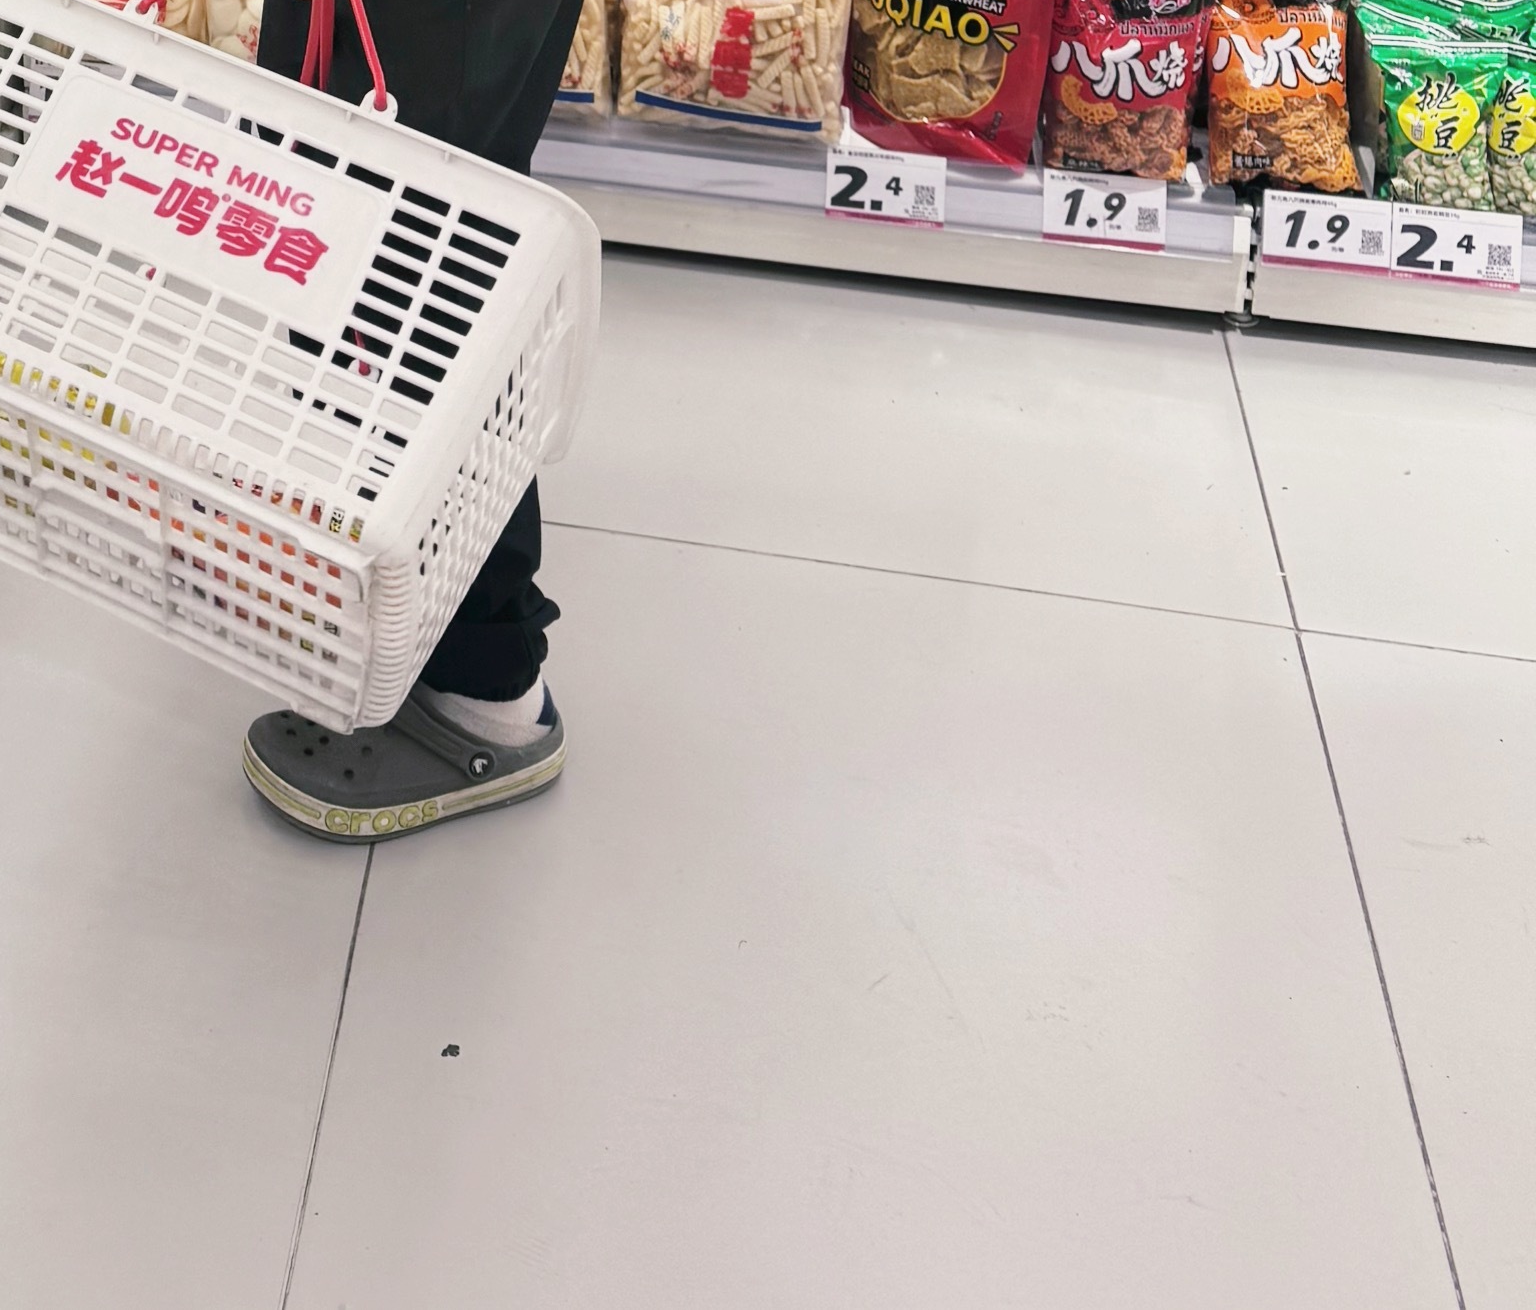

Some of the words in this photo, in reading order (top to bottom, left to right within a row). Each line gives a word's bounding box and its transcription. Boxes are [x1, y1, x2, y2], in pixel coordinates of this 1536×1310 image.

[1051, 38, 1187, 102] 八爪烧
[1212, 27, 1344, 89] 八爪烧
[111, 116, 219, 177] SUPER
[225, 163, 315, 216] MING
[831, 165, 903, 211] 2.4
[55, 138, 331, 288] 赵一鸣零食
[1064, 189, 1127, 230] 1.9
[1285, 210, 1350, 250] 1.9
[1396, 224, 1476, 273] 2.4
[324, 798, 441, 837] crocs
